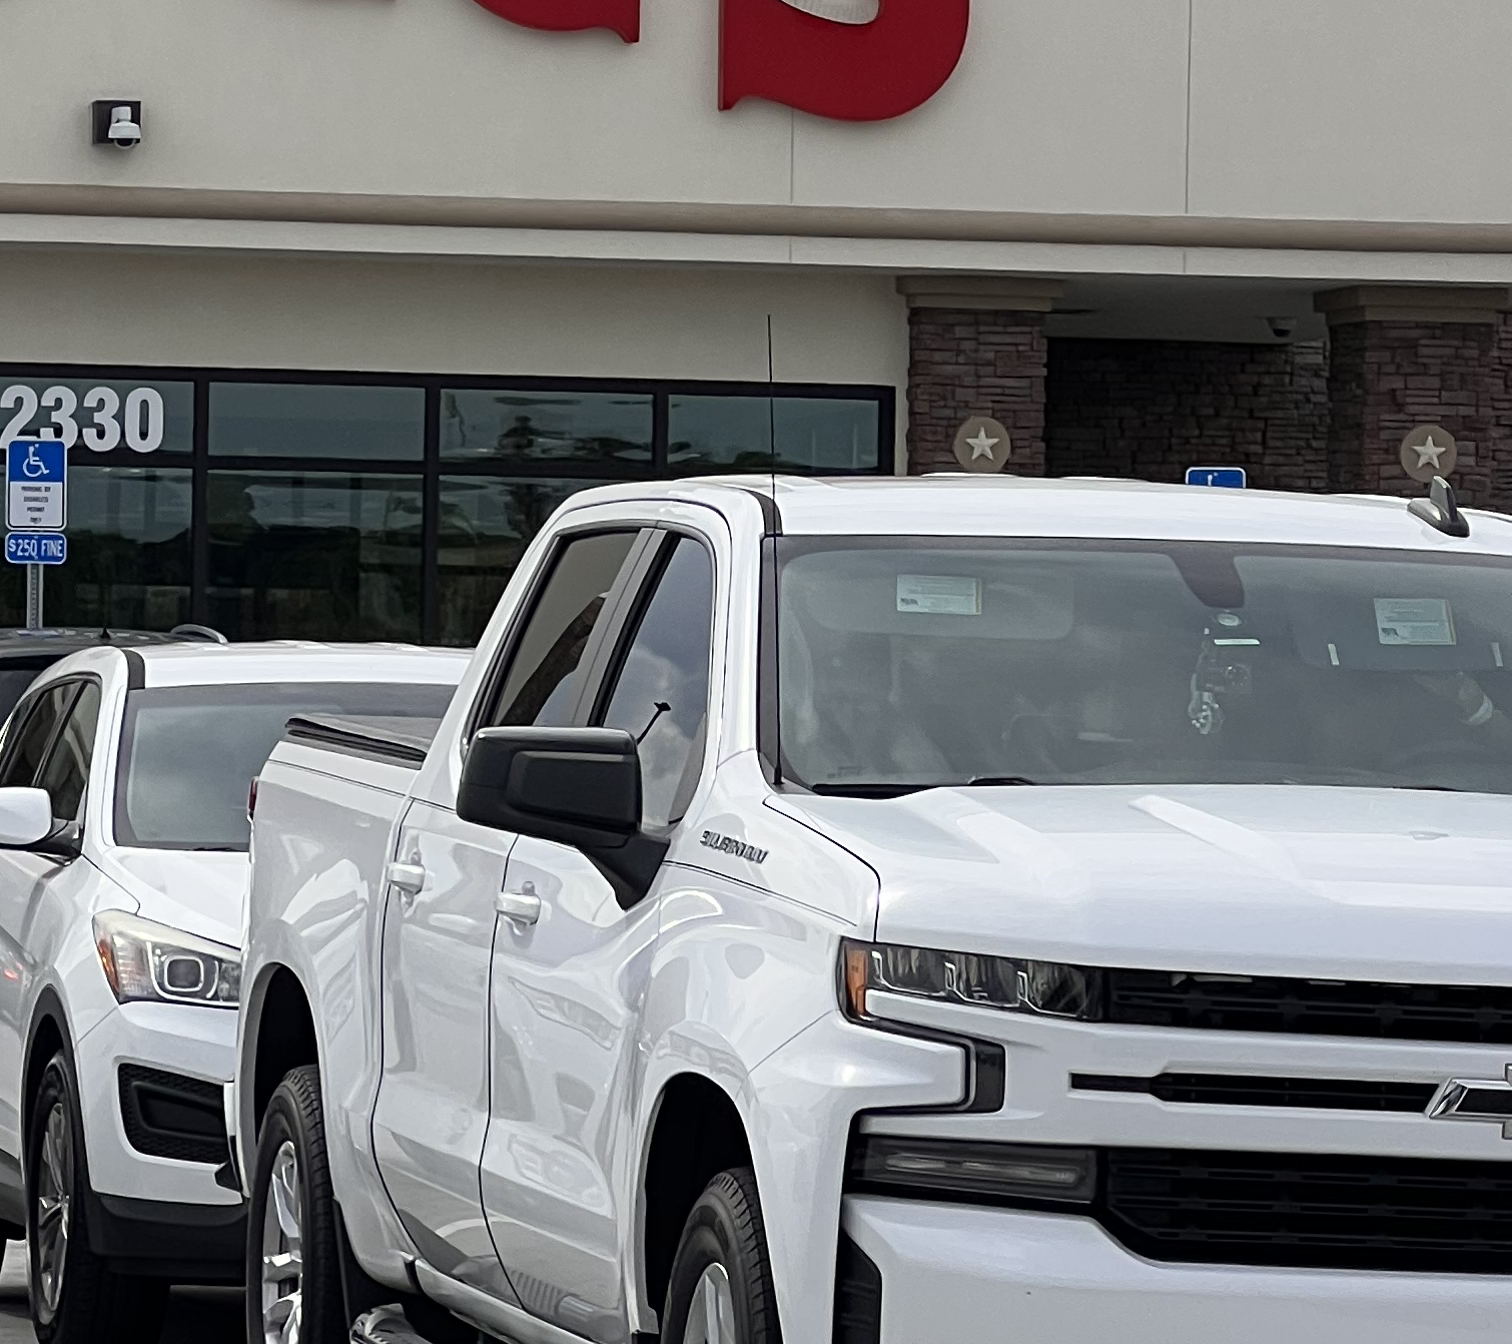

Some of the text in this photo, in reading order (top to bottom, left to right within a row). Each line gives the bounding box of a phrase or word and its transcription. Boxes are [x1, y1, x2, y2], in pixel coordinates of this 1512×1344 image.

[0, 384, 164, 453] 2330
[8, 539, 63, 557] $250 FINE
